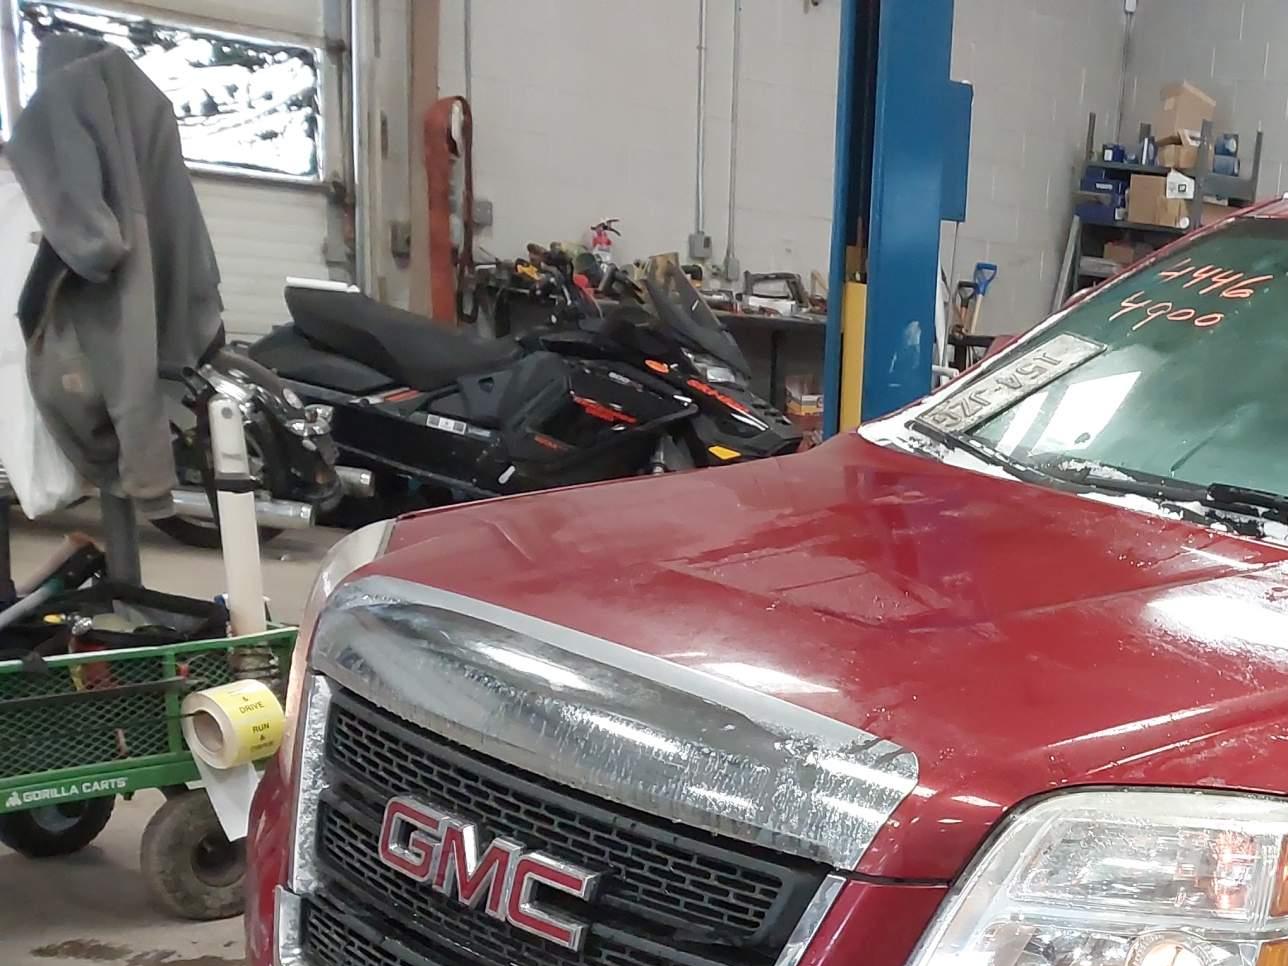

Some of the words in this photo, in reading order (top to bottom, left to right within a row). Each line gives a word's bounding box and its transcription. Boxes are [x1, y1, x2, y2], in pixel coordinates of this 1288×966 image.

[1158, 257, 1273, 298] 4446
[1108, 290, 1225, 331] 4900
[239, 701, 265, 714] DRIVE
[252, 722, 270, 734] RUN
[22, 785, 80, 803] GORILLA
[81, 777, 128, 793] CARTS
[378, 795, 600, 952] GMC
